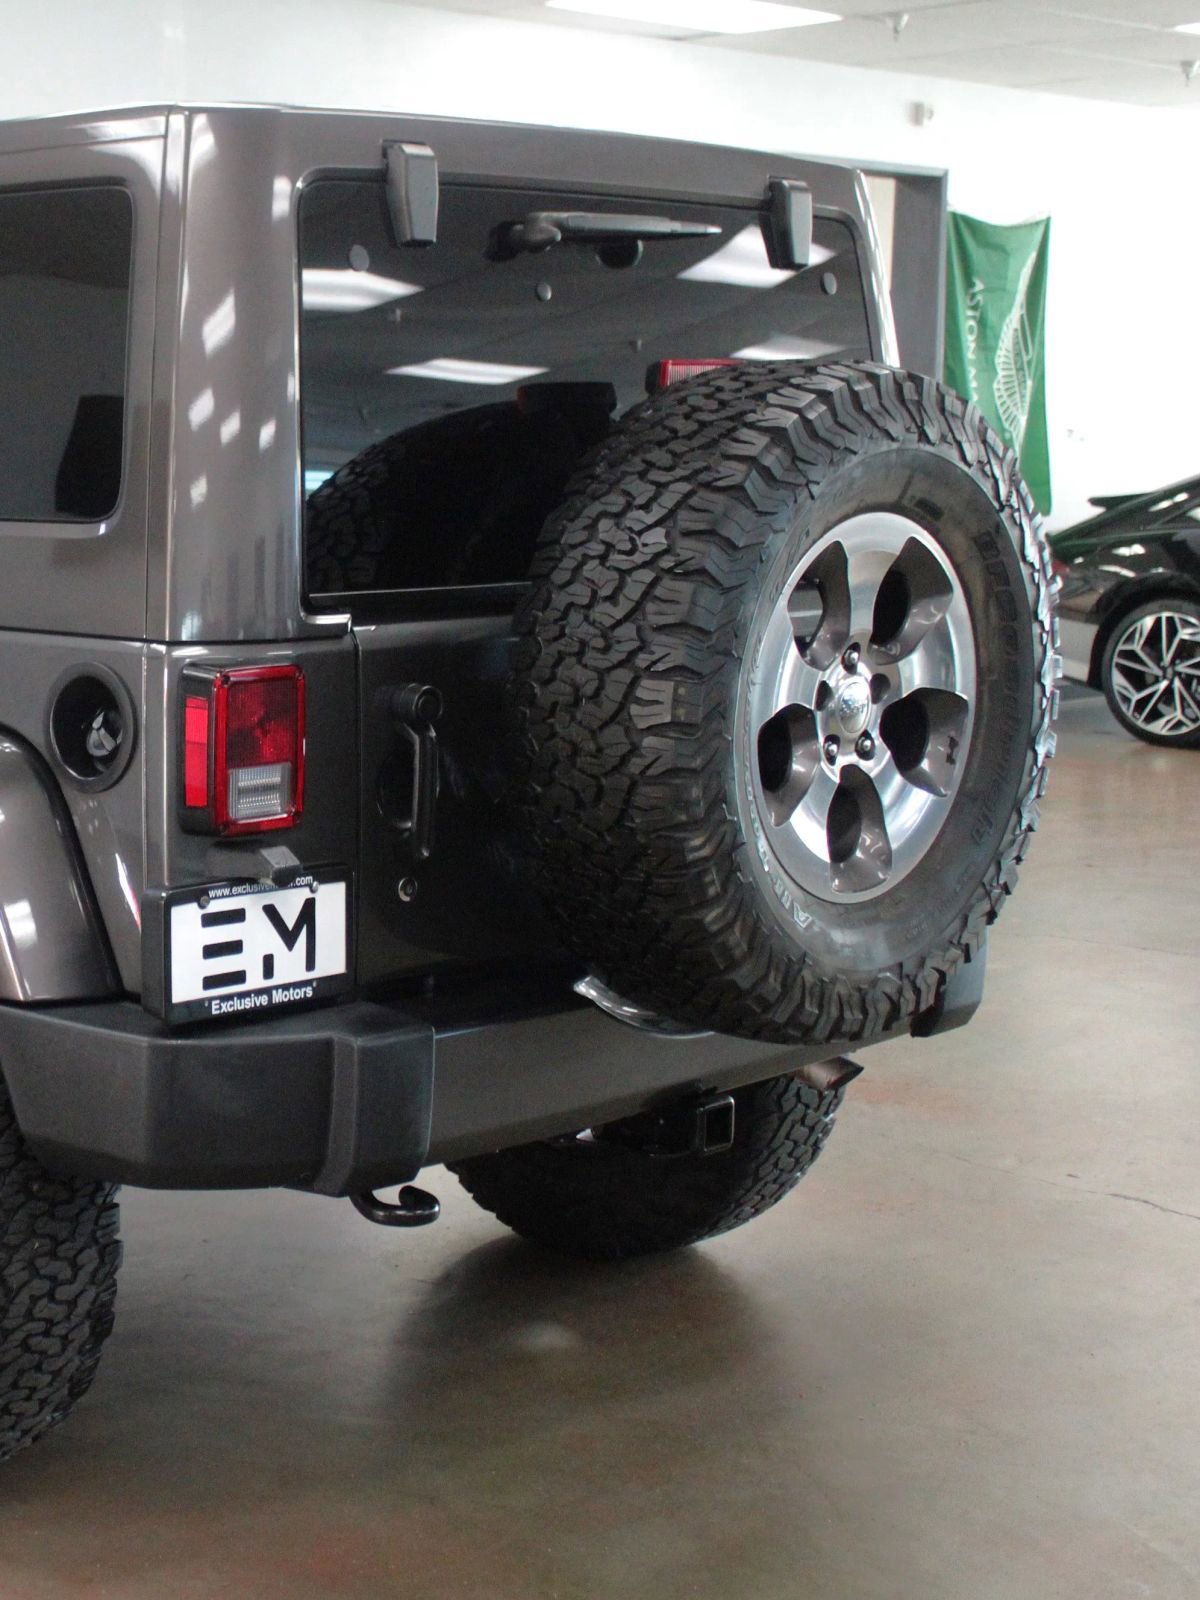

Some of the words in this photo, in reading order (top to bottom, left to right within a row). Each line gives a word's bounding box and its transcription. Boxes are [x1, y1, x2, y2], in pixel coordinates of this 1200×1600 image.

[966, 278, 985, 359] ASTON
[201, 897, 316, 991] EM
[211, 994, 268, 1015] Exclusive
[272, 986, 313, 1004] Motors
